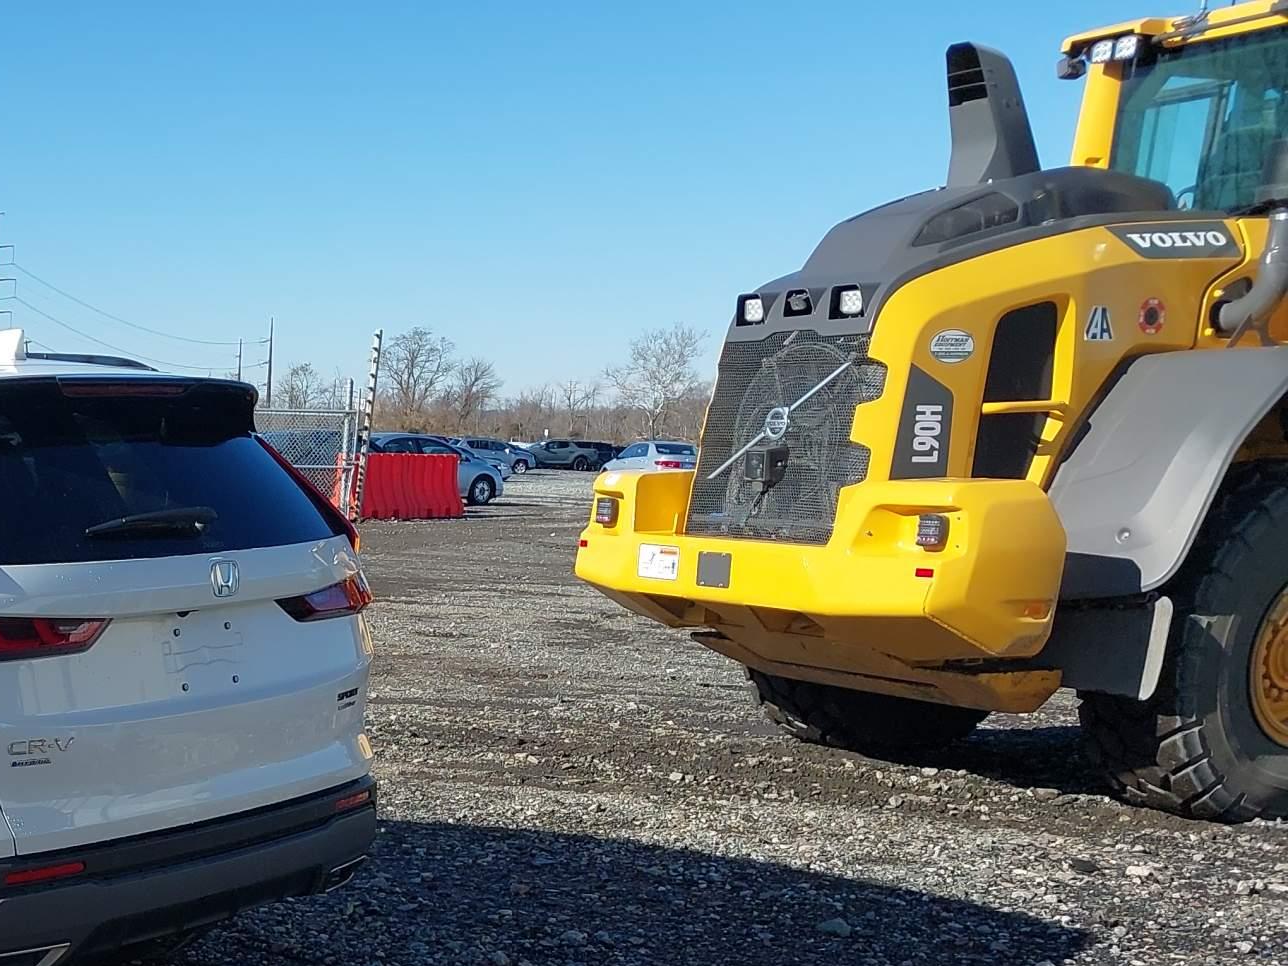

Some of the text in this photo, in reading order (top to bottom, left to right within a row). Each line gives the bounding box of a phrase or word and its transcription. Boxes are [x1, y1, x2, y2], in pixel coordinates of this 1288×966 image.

[1126, 231, 1227, 248] VOLVO
[912, 405, 943, 463] L90H
[8, 737, 75, 755] CR-V
